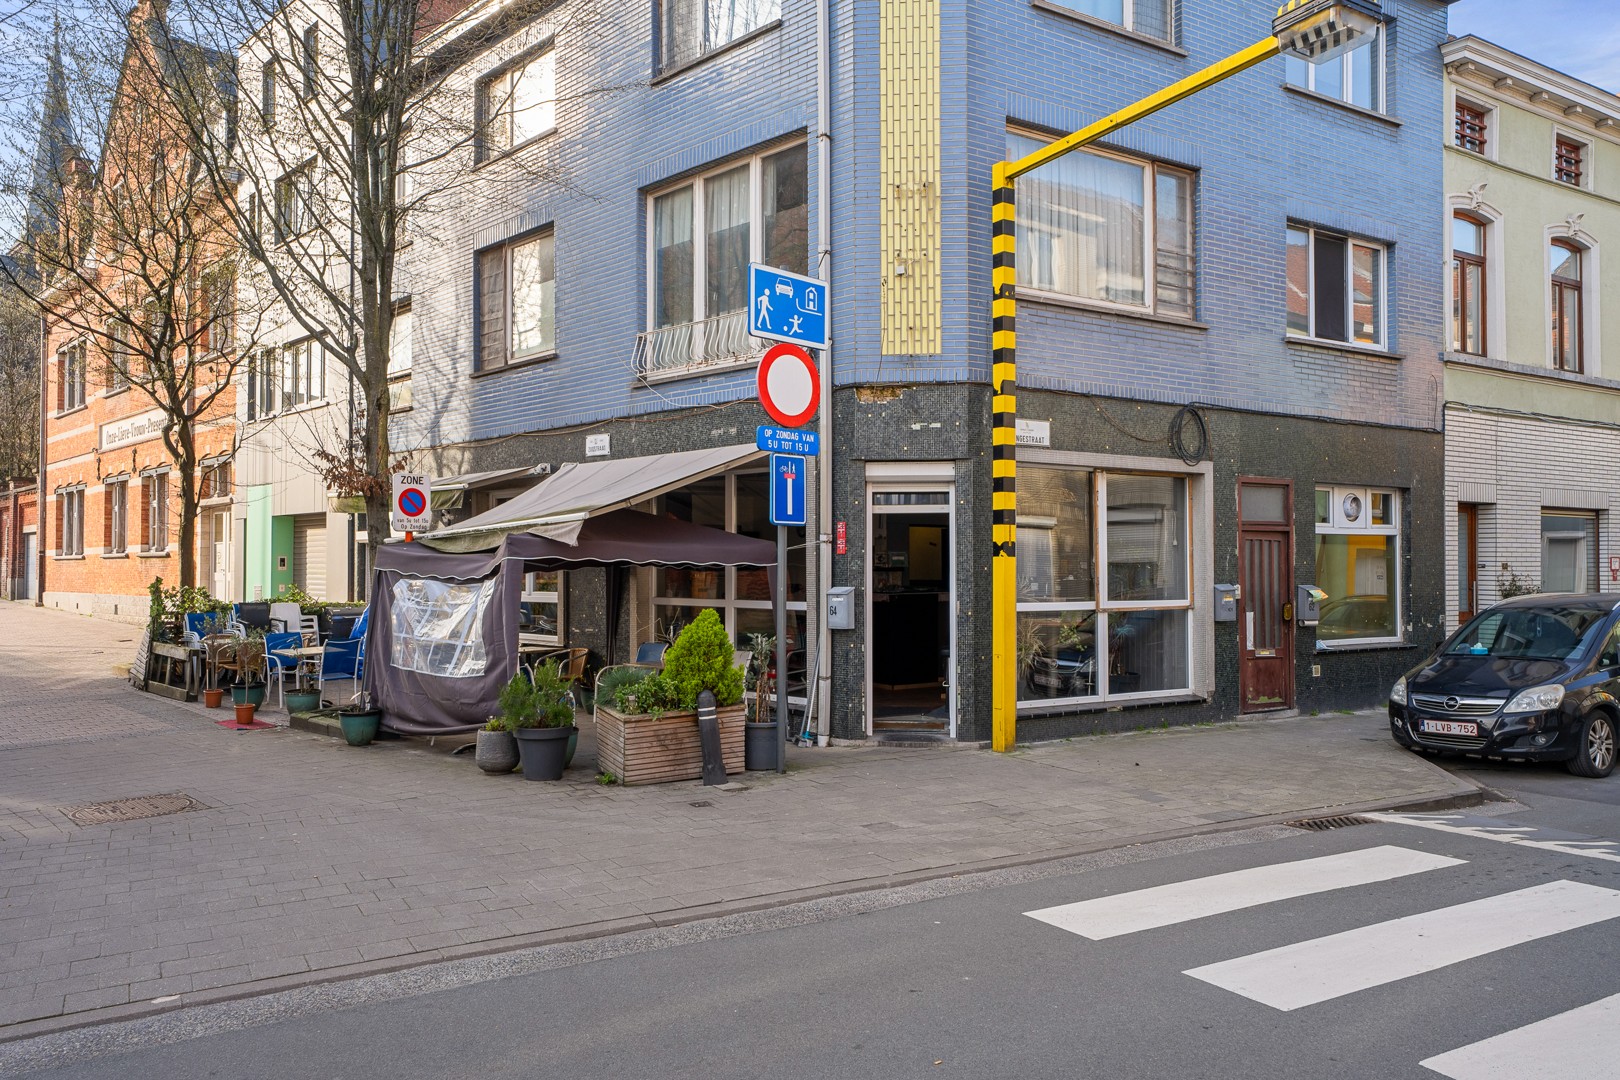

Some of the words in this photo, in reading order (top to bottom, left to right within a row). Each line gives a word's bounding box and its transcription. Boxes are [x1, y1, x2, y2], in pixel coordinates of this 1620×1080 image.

[764, 429, 773, 438] OP
[776, 430, 799, 441] ZONDAG
[801, 433, 815, 443] VAN
[1015, 434, 1045, 444] NGESTRAAT
[781, 441, 793, 450] TOT
[400, 475, 424, 485] ZONE
[829, 605, 837, 616] 64
[1426, 721, 1476, 734] 1-LVB-752
